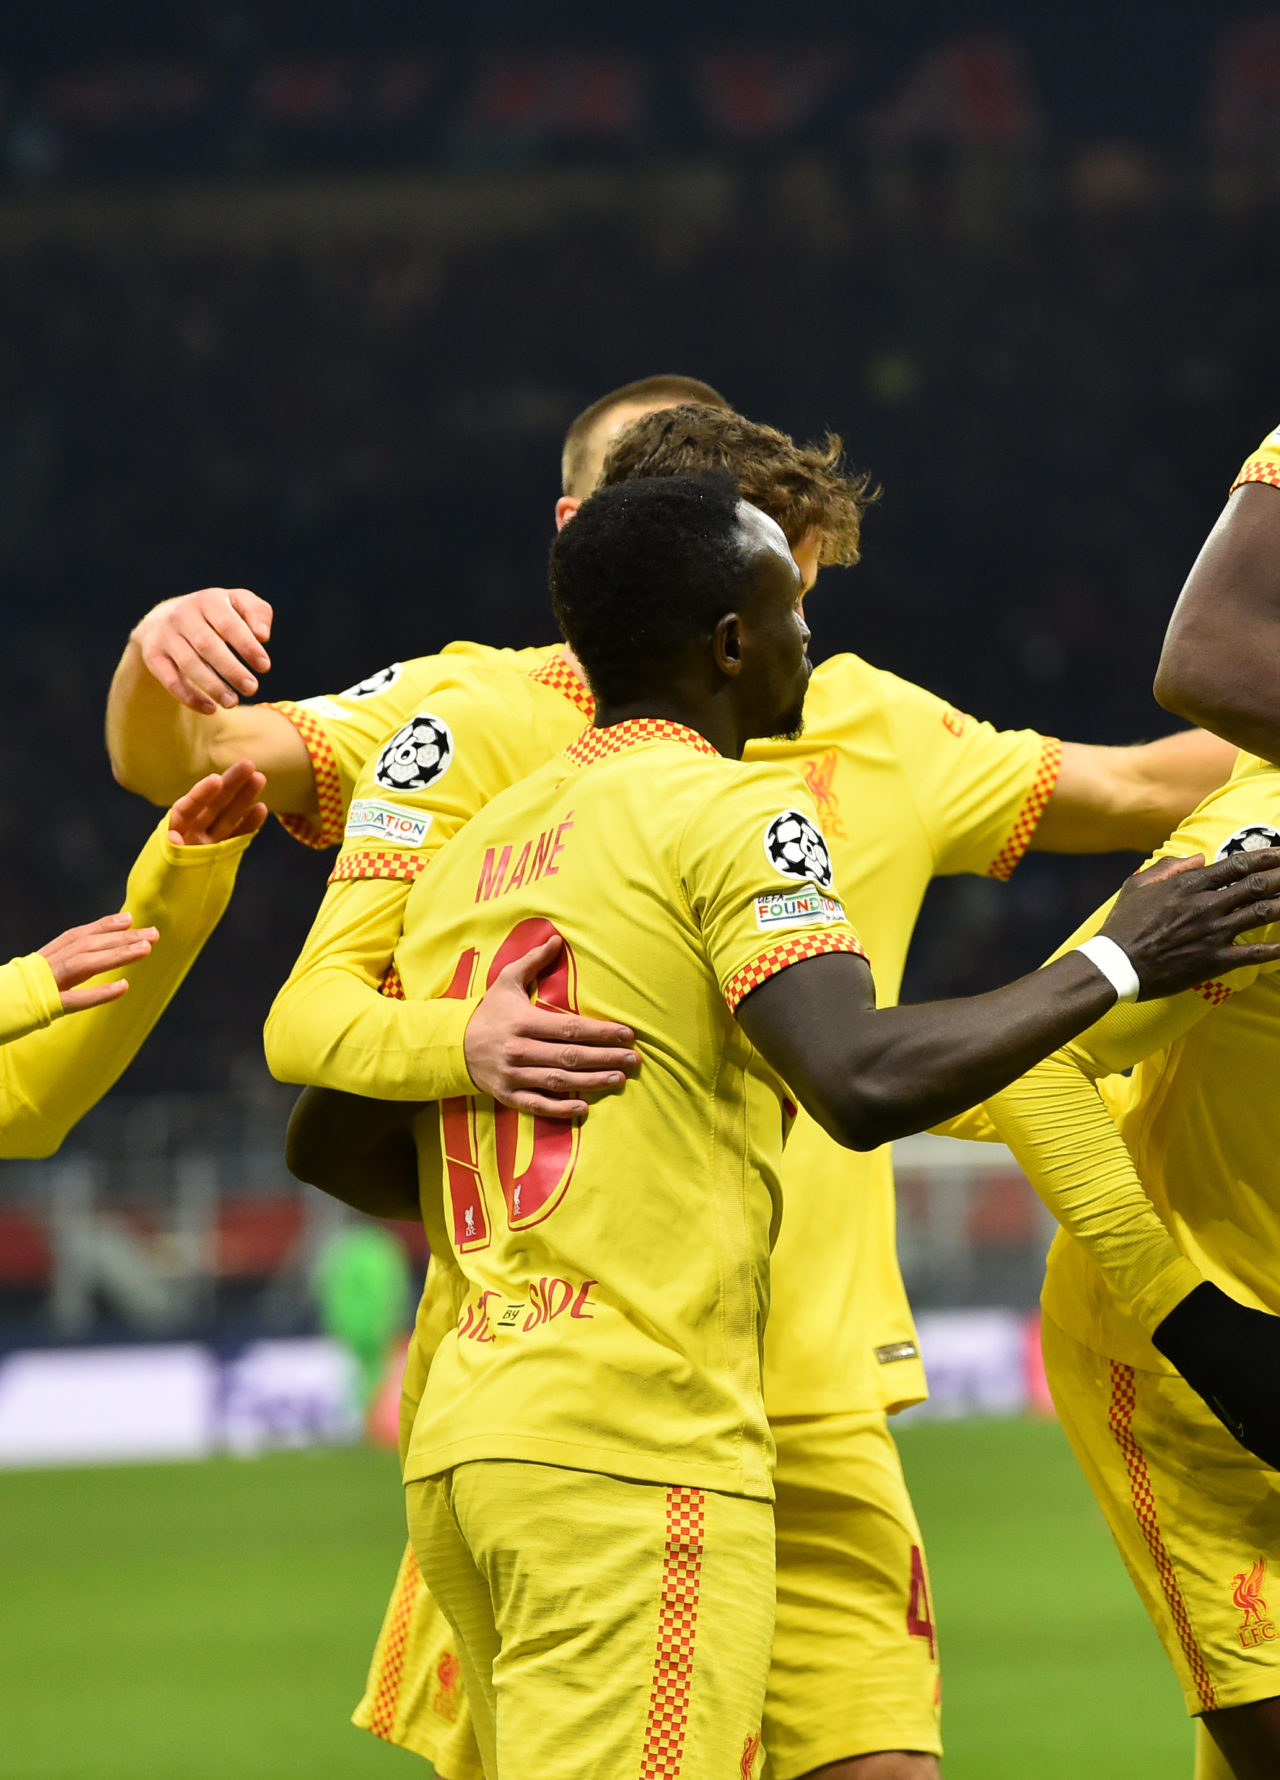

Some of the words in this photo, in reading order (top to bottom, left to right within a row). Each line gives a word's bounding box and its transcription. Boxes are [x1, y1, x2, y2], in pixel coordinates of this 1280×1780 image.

[475, 810, 575, 904] MANÉ
[502, 1310, 520, 1320] BY
[522, 1277, 599, 1332] SIDE
[907, 1545, 937, 1661] 4
